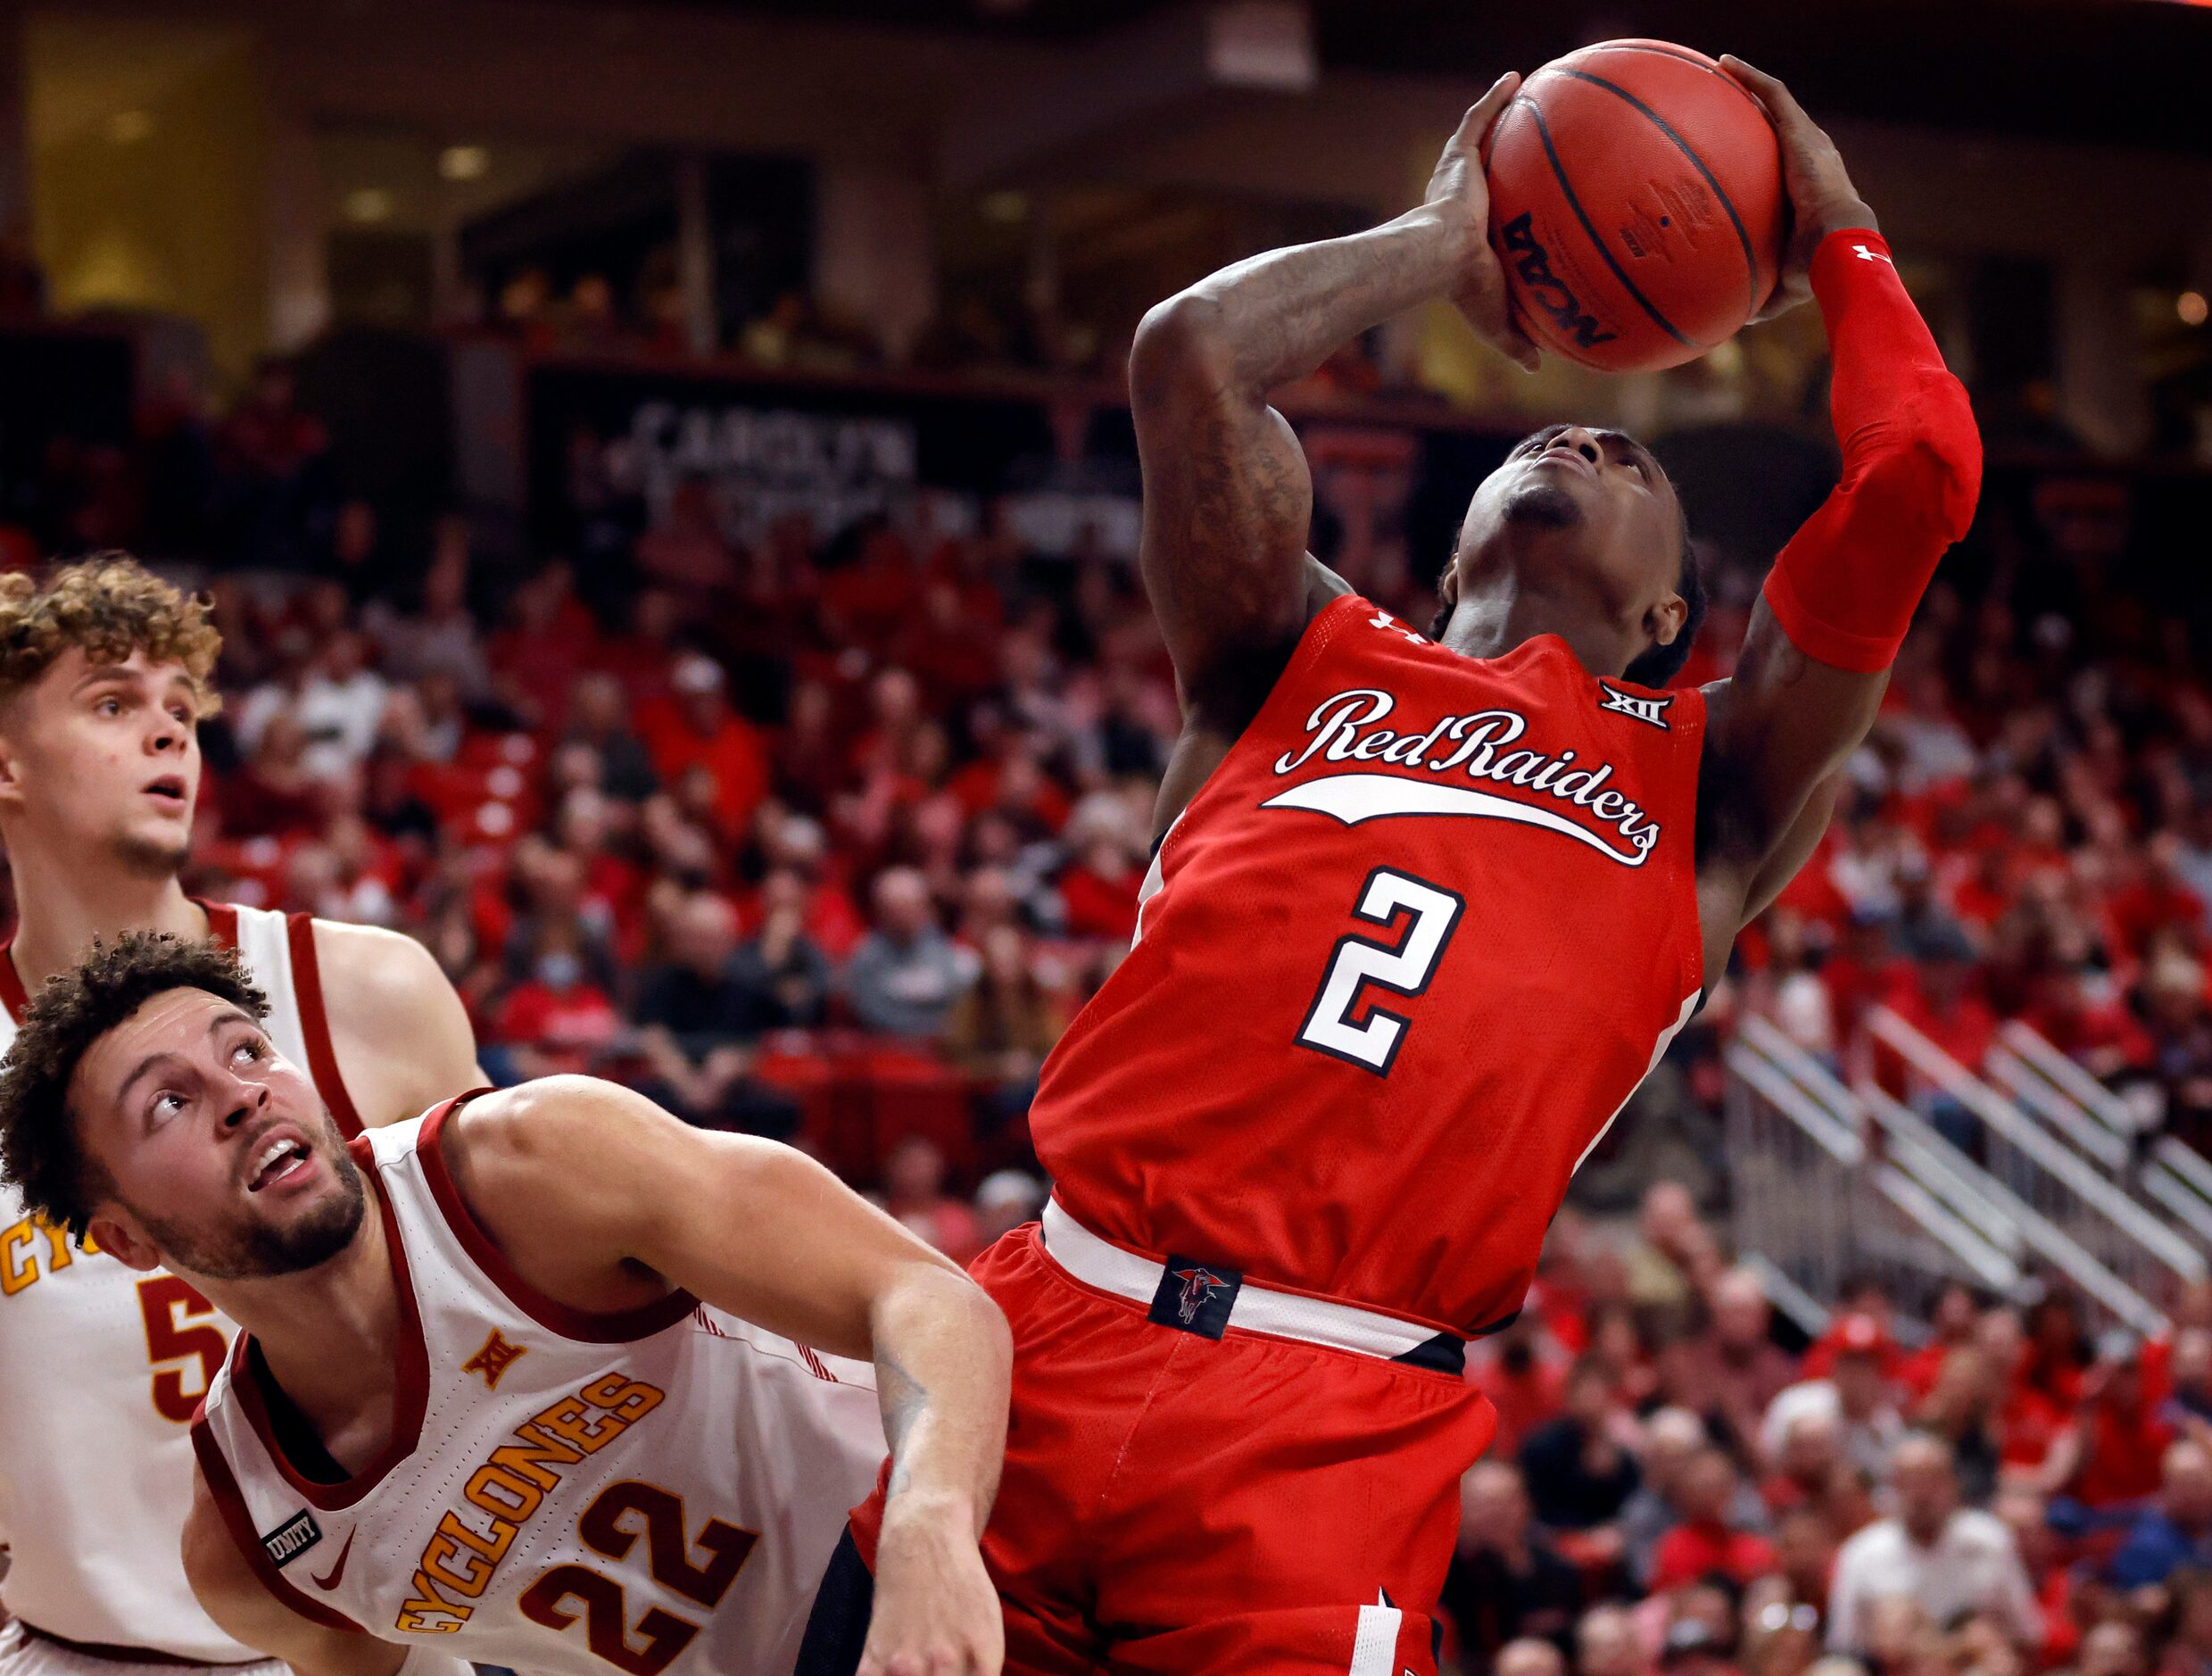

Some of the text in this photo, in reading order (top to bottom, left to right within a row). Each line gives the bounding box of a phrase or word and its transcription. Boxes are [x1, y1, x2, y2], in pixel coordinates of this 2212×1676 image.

[1503, 211, 1618, 349] NCAA
[1273, 688, 1661, 854] Red Raiders
[1293, 865, 1467, 1079] 2
[135, 1274, 228, 1423] 5
[265, 1515, 316, 1562] UNITY
[394, 1372, 666, 1634] CYCLONES
[517, 1478, 763, 1676] 22
